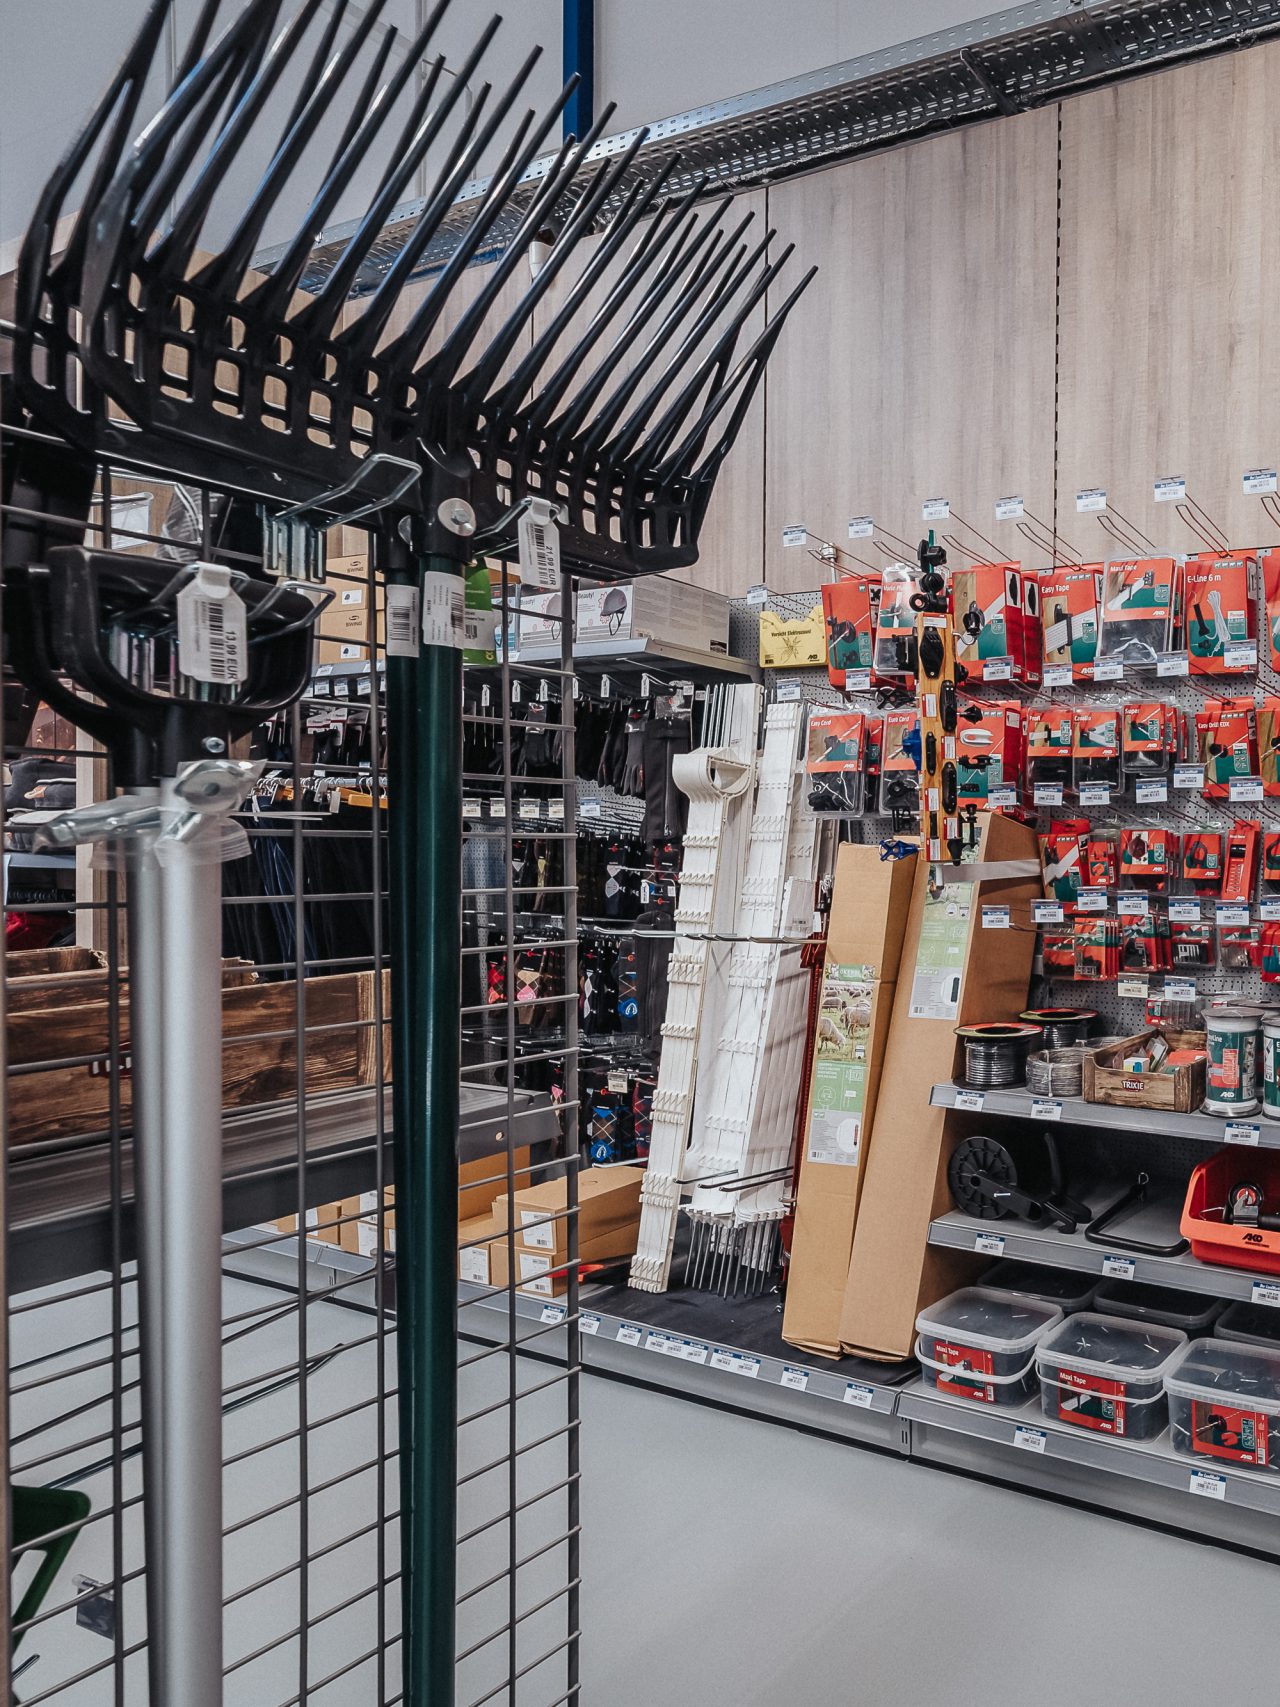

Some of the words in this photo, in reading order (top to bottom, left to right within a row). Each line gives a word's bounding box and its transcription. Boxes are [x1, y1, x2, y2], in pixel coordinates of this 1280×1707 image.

[545, 546, 555, 569] 21,99
[549, 570, 557, 586] EUR
[1187, 574, 1207, 583] E-Line
[1209, 573, 1214, 582] 6
[1041, 586, 1054, 595] Easy
[1055, 583, 1070, 593] Tape
[225, 631, 237, 656] 13,99
[226, 658, 238, 680] EUR
[1122, 1080, 1144, 1090] TRIXIE
[1242, 1232, 1263, 1242] AKO
[1059, 1371, 1072, 1381] Maxi
[1072, 1374, 1087, 1385] Tape
